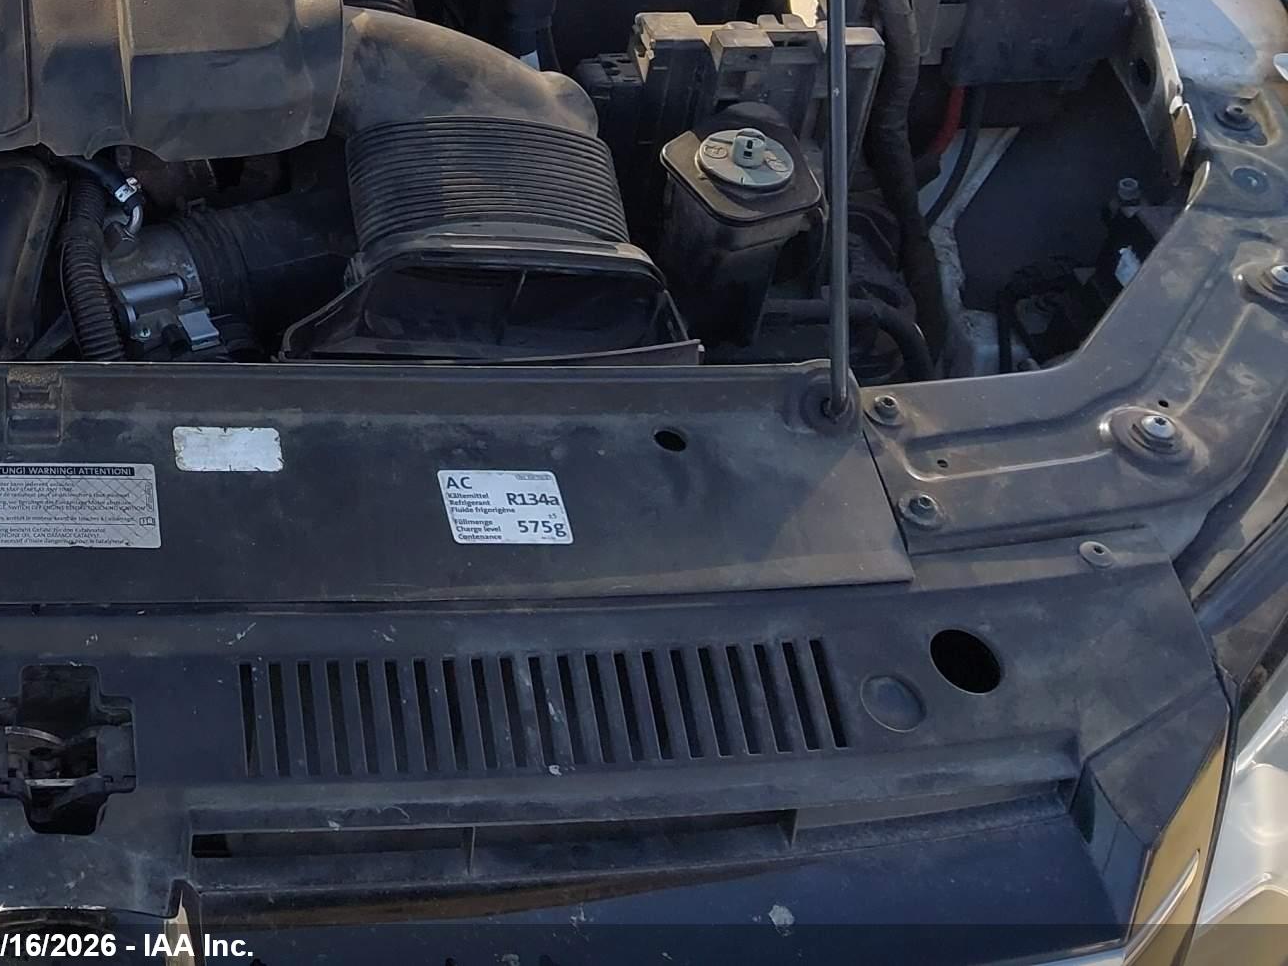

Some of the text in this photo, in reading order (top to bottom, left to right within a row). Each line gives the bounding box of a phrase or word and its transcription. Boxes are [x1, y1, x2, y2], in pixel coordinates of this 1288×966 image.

[27, 467, 76, 475] WARNING!
[78, 467, 132, 475] ATTENTION!
[446, 477, 473, 489] AC
[448, 499, 491, 507] Refrigerant
[505, 493, 560, 506] R134a
